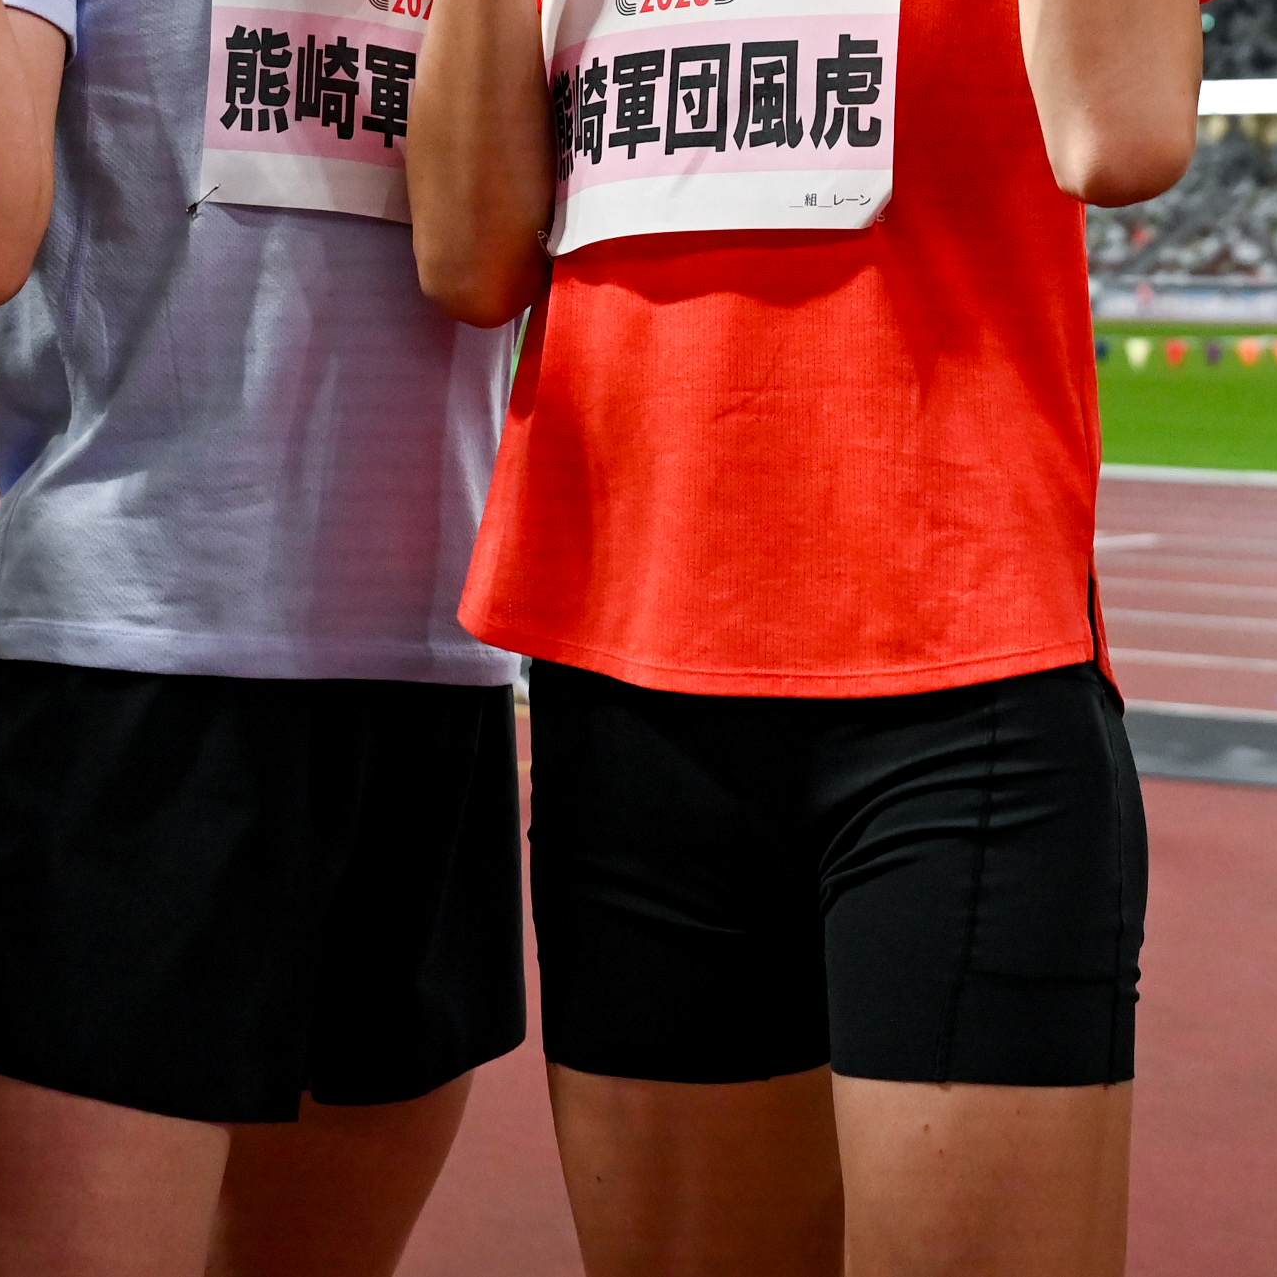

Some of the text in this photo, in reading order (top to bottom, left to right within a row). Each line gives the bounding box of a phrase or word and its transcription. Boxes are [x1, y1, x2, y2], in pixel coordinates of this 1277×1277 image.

[220, 25, 417, 149] 熊崎軍
[833, 192, 871, 206] レーン
